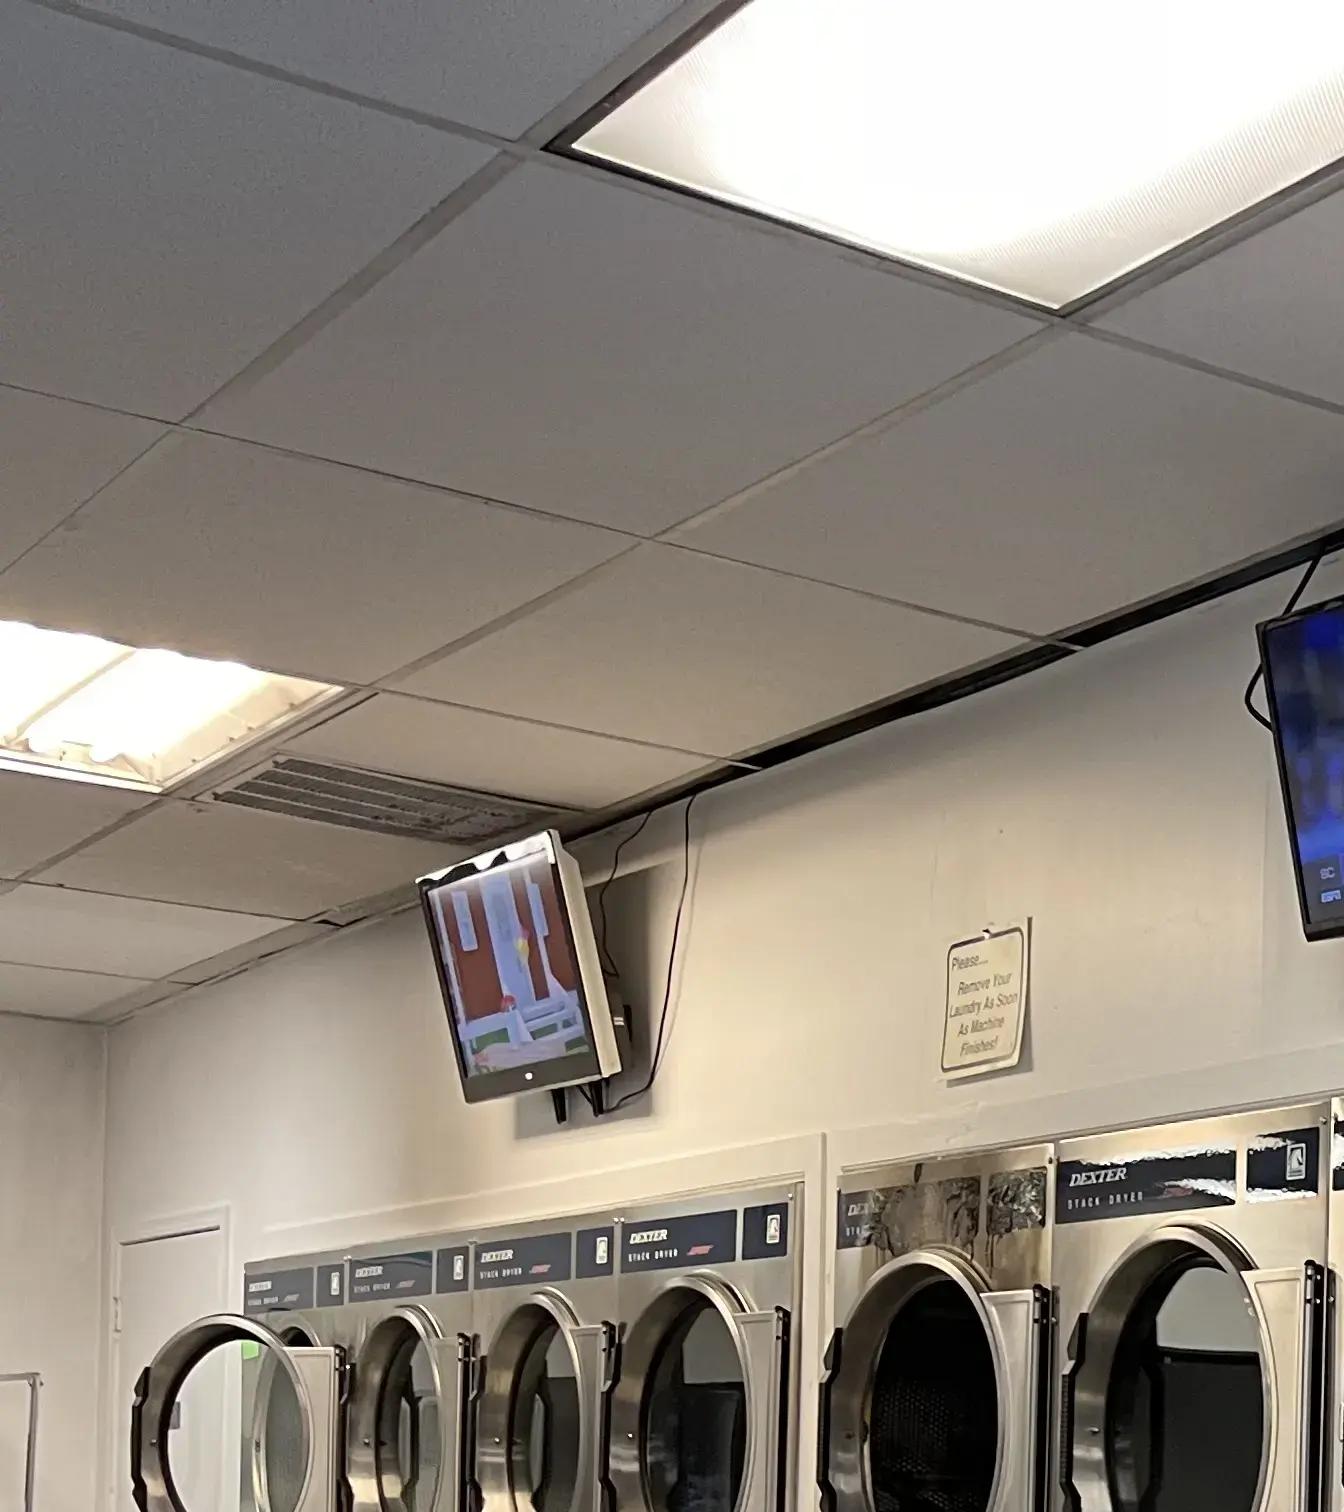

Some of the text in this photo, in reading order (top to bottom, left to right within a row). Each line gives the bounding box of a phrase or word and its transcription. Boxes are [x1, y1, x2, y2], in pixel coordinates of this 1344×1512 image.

[957, 973, 1012, 996] Remove Your
[949, 1000, 982, 1018] Laundry
[996, 993, 1018, 1008] Soon
[970, 1016, 1005, 1034] Machine
[1069, 1167, 1127, 1187] DEXTER
[630, 1229, 668, 1244] DEXTER
